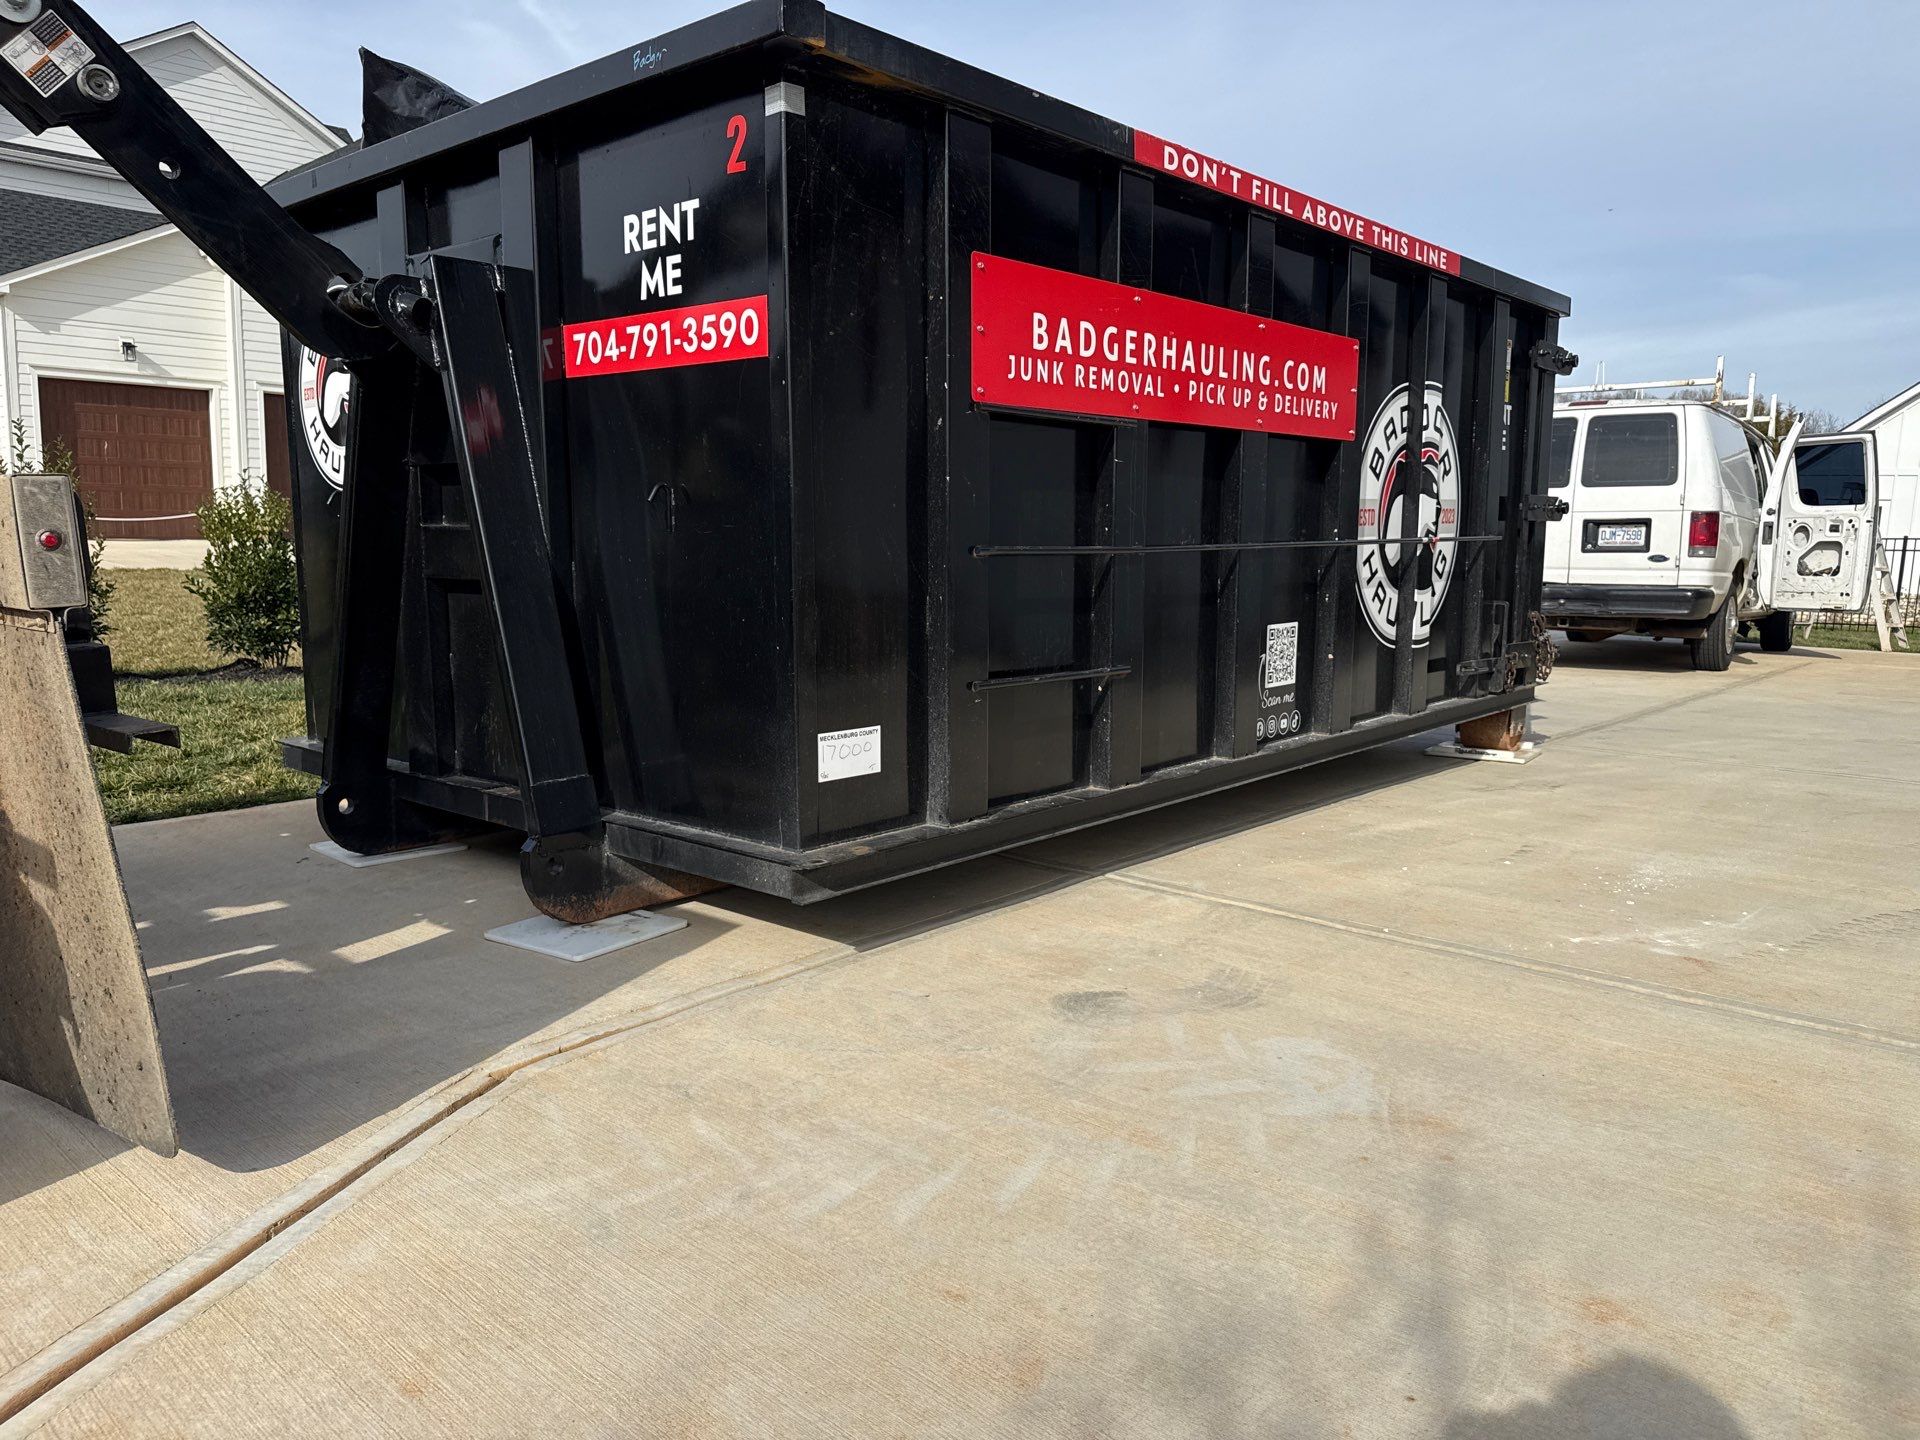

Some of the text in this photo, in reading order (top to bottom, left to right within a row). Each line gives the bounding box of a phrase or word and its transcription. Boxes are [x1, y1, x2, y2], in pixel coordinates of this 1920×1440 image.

[726, 114, 747, 175] 2
[623, 198, 700, 255] RENT
[1163, 145, 1447, 270] DON'T FILL ABOVE THIS LINE
[641, 253, 682, 301] ME
[573, 308, 759, 366] 704-791-3590
[1032, 312, 1326, 395] BADGERHAULING.COM
[1008, 355, 1339, 420] JUNK REMOVAL PICK UP & DELIVERY
[1262, 689, 1295, 708] Scan me
[819, 728, 879, 742] MECKLENBURG COUNTY
